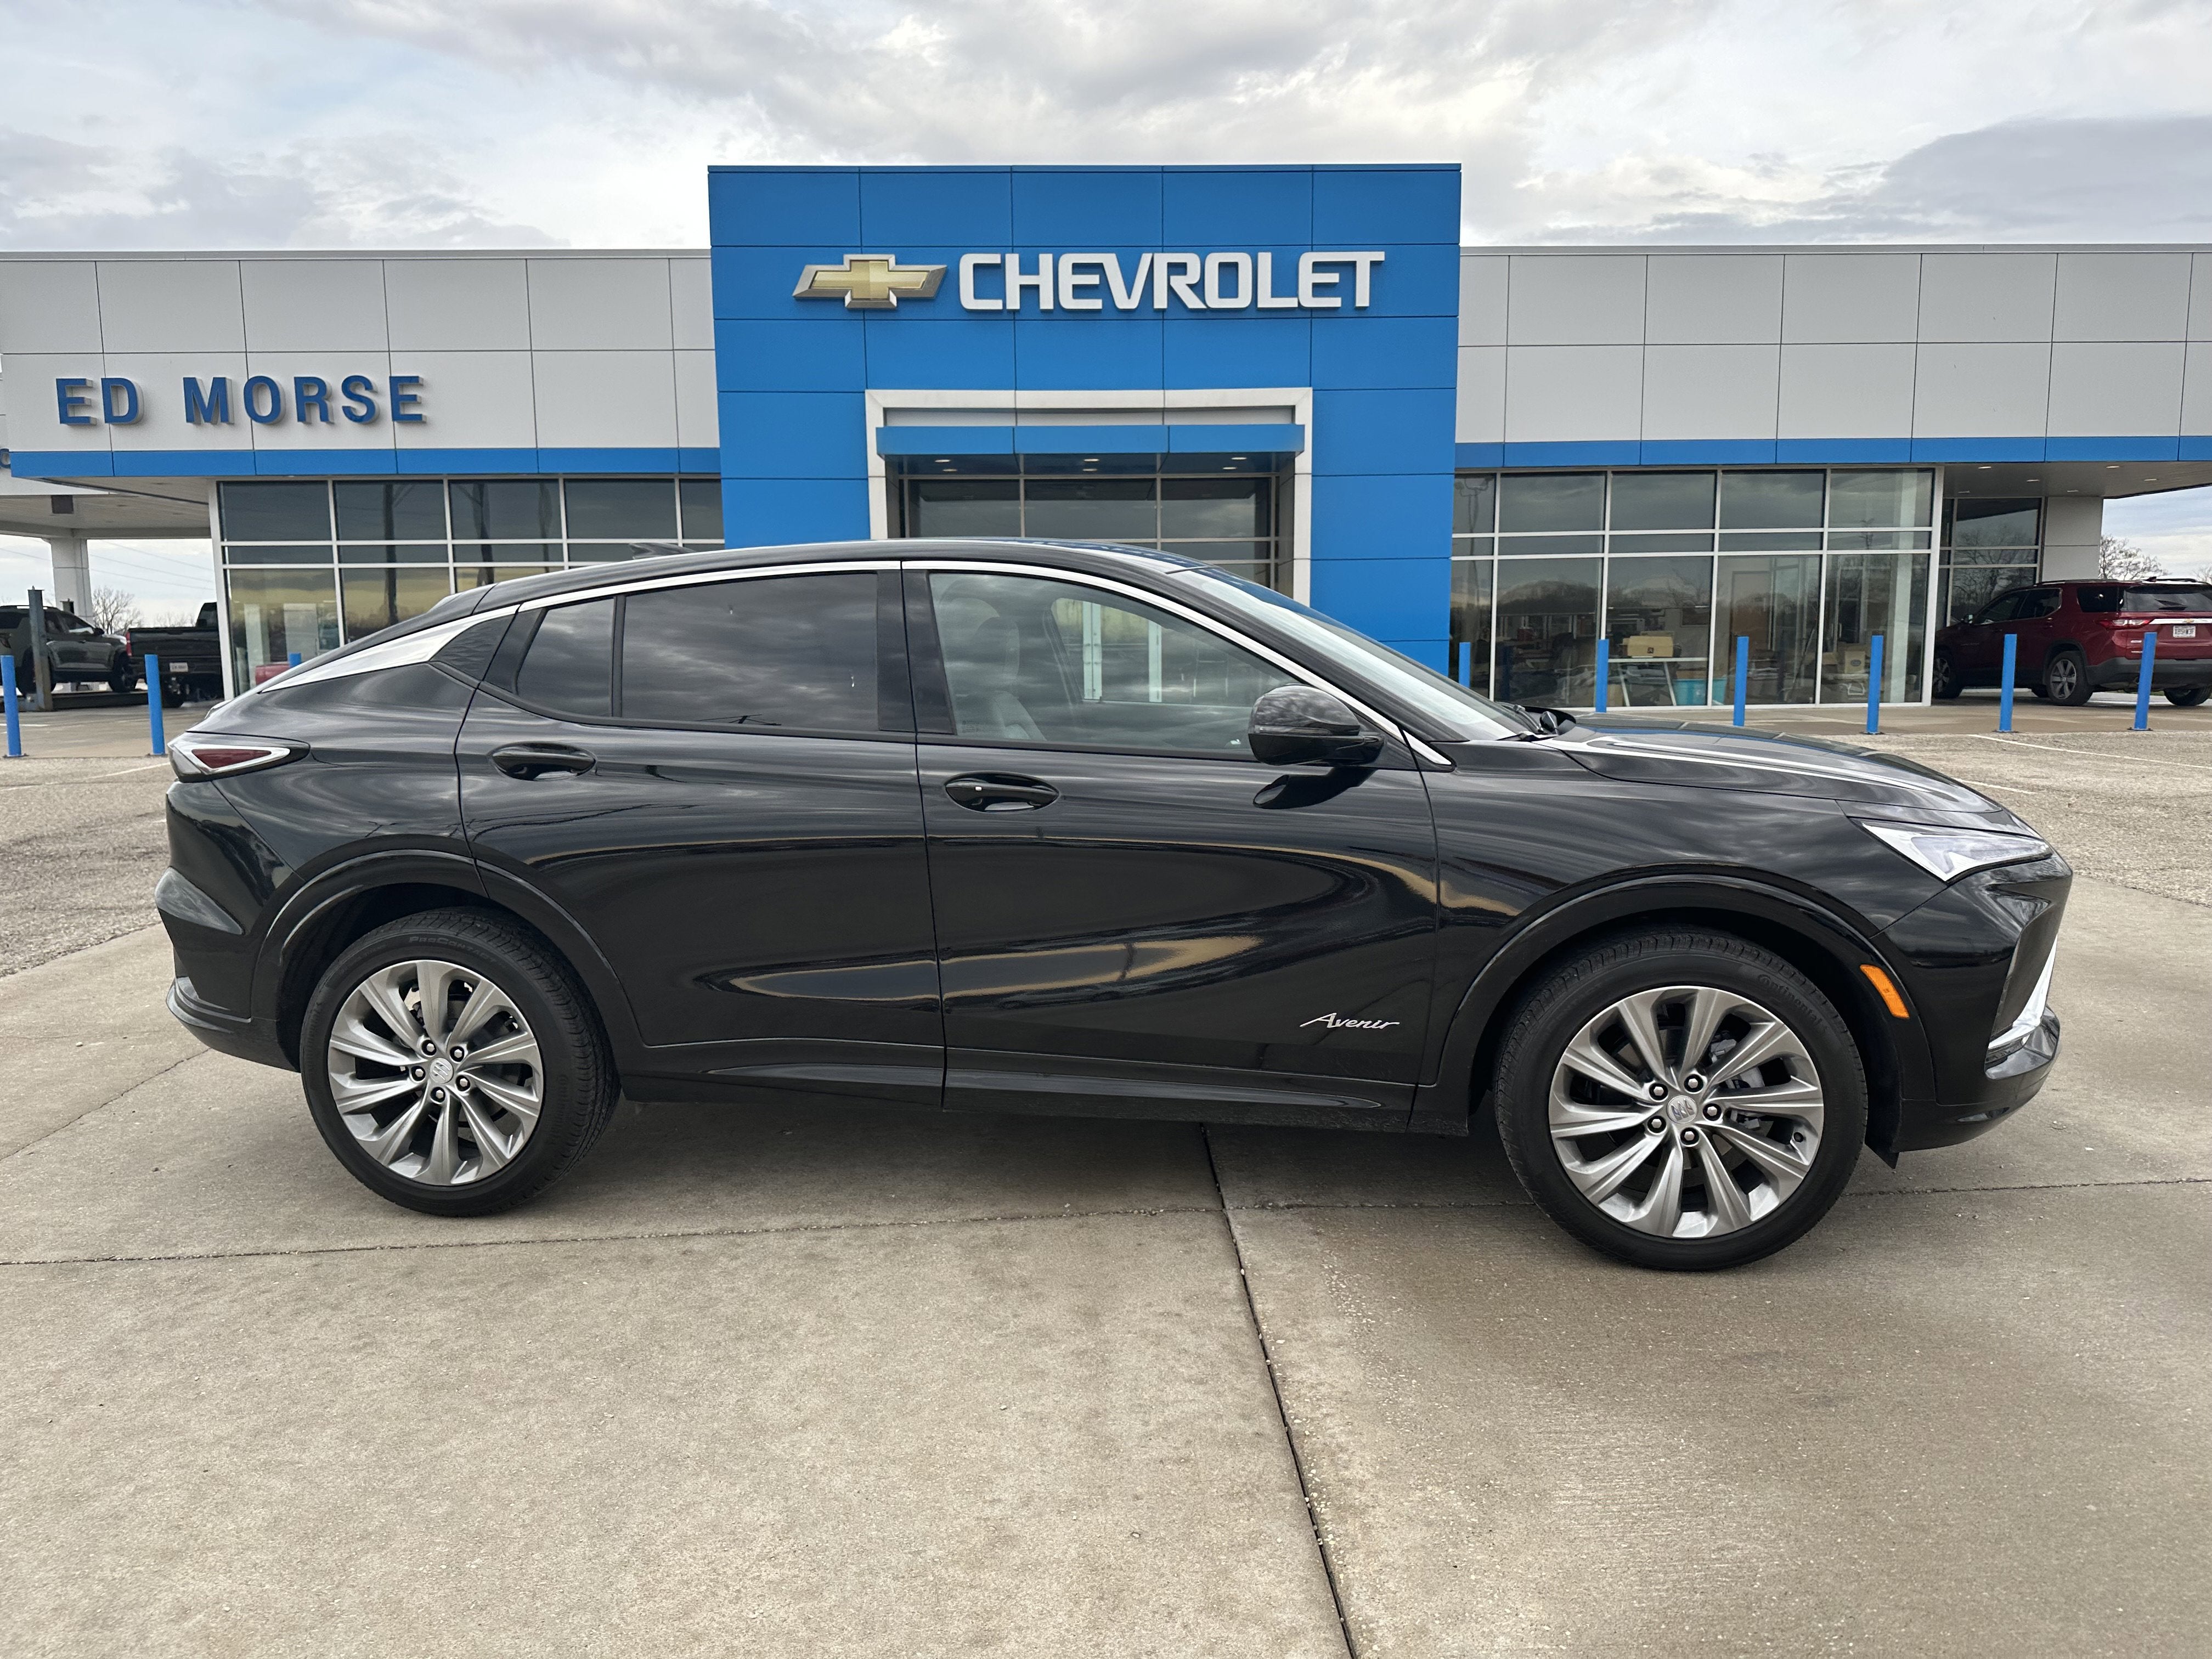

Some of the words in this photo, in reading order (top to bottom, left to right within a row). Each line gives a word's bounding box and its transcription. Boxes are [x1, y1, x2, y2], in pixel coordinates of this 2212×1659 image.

[959, 251, 1386, 311] CHEVROLET
[55, 376, 144, 426] ED
[182, 375, 427, 425] MORSE
[1299, 1012, 1401, 1029] Avenir
